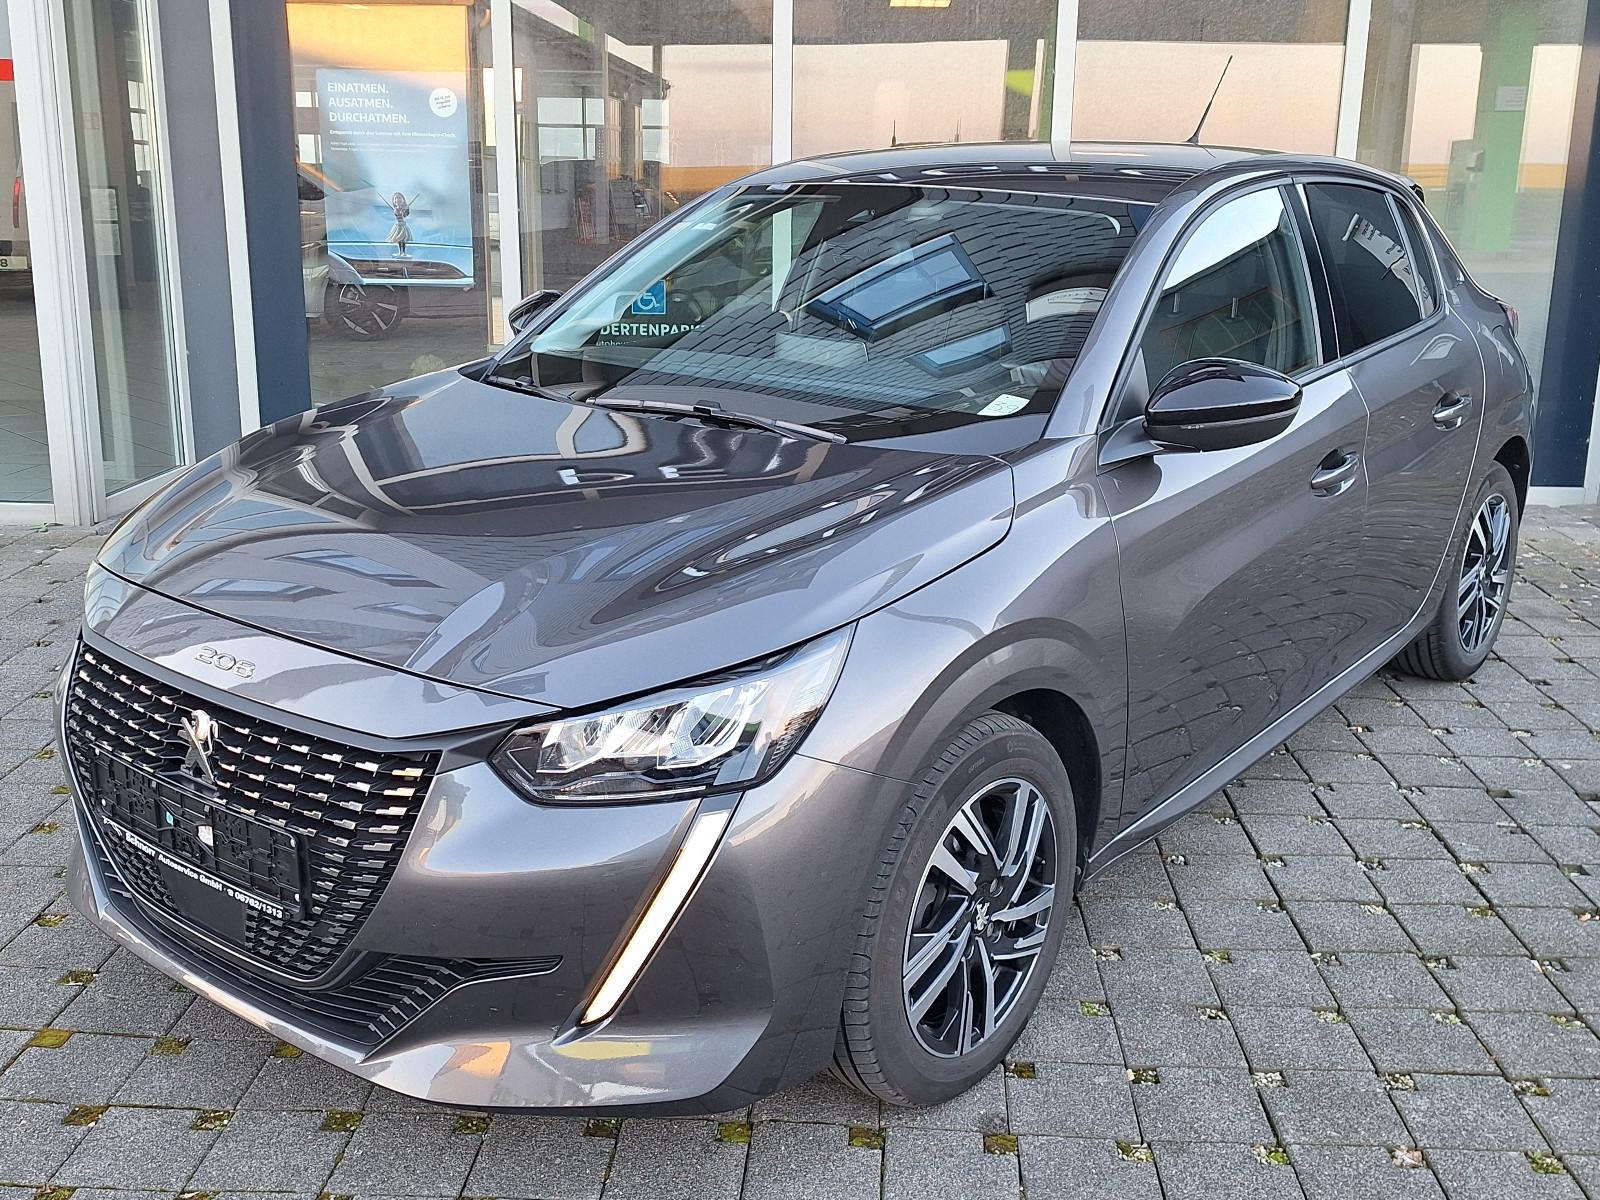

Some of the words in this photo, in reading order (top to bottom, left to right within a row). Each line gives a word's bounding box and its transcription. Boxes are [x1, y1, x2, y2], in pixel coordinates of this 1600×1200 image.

[327, 82, 389, 94] EINATMEN.
[328, 97, 393, 109] AUSATMEN.
[329, 112, 411, 124] DURCHATMEN.
[194, 646, 256, 679] 208
[158, 852, 199, 880] Autoservice
[199, 874, 224, 892] GmbH
[234, 891, 283, 919] 06782/1313
